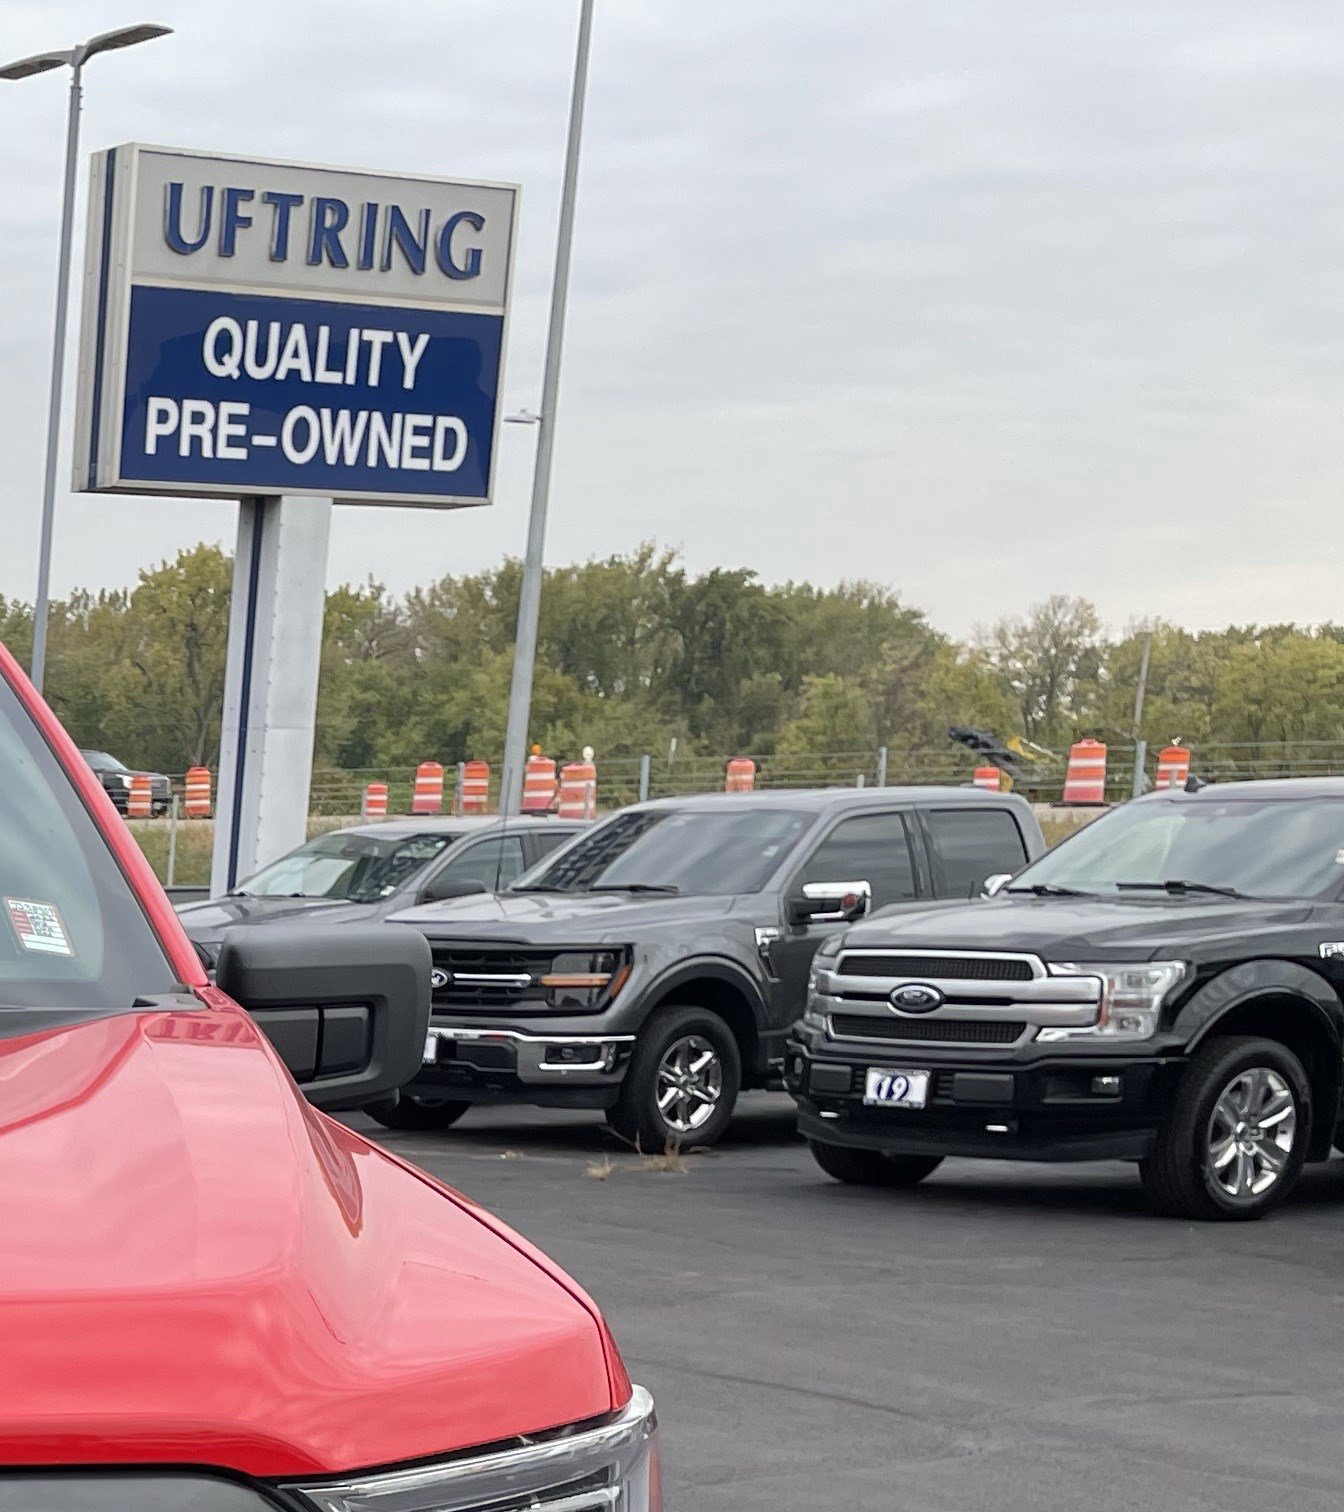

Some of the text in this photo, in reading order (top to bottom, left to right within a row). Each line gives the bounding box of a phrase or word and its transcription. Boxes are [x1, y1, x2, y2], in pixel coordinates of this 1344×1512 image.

[163, 181, 486, 281] UFTRING
[202, 315, 430, 390] QUALITY
[144, 396, 468, 472] PRE-OWNED
[878, 1075, 908, 1101] 19
